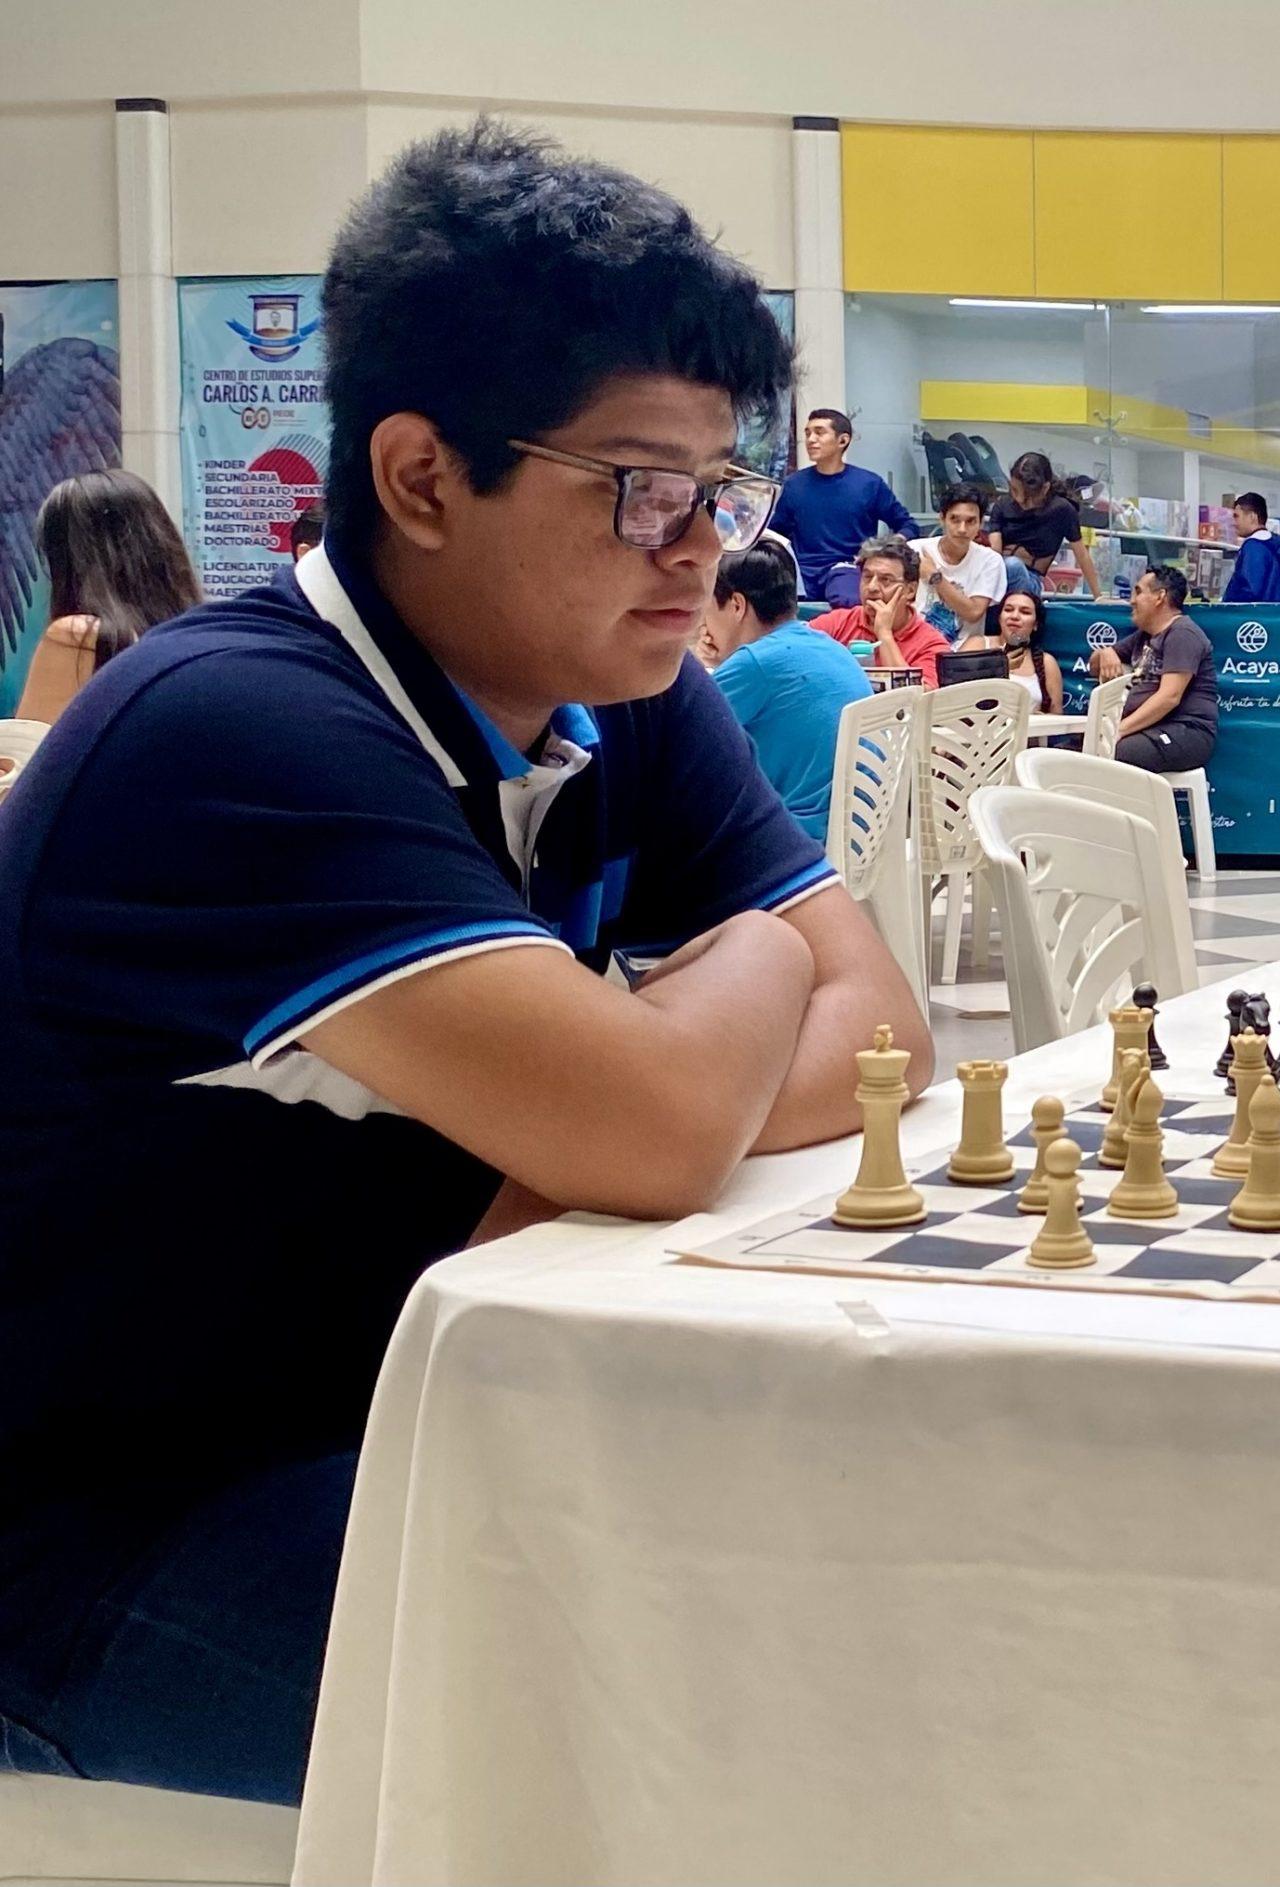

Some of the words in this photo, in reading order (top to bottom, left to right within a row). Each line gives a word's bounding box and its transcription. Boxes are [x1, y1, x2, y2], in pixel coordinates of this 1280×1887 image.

[203, 370, 236, 381] CENTRO
[239, 370, 249, 381] DE
[250, 370, 292, 381] ESTUDIOS
[203, 384, 259, 403] CARLOS
[261, 385, 275, 403] A.
[205, 460, 246, 469] KINDER
[205, 473, 279, 482] SECUNDARIA
[205, 486, 291, 495] BACHILLERATO
[294, 486, 323, 495] MIXT
[205, 499, 294, 508] ESCOLARIZADO
[205, 511, 291, 521] BACHILLERATO
[204, 524, 269, 533] MAESTRIAS
[204, 537, 279, 546] DOCTORADO
[203, 562, 280, 571] LICENCIATUR
